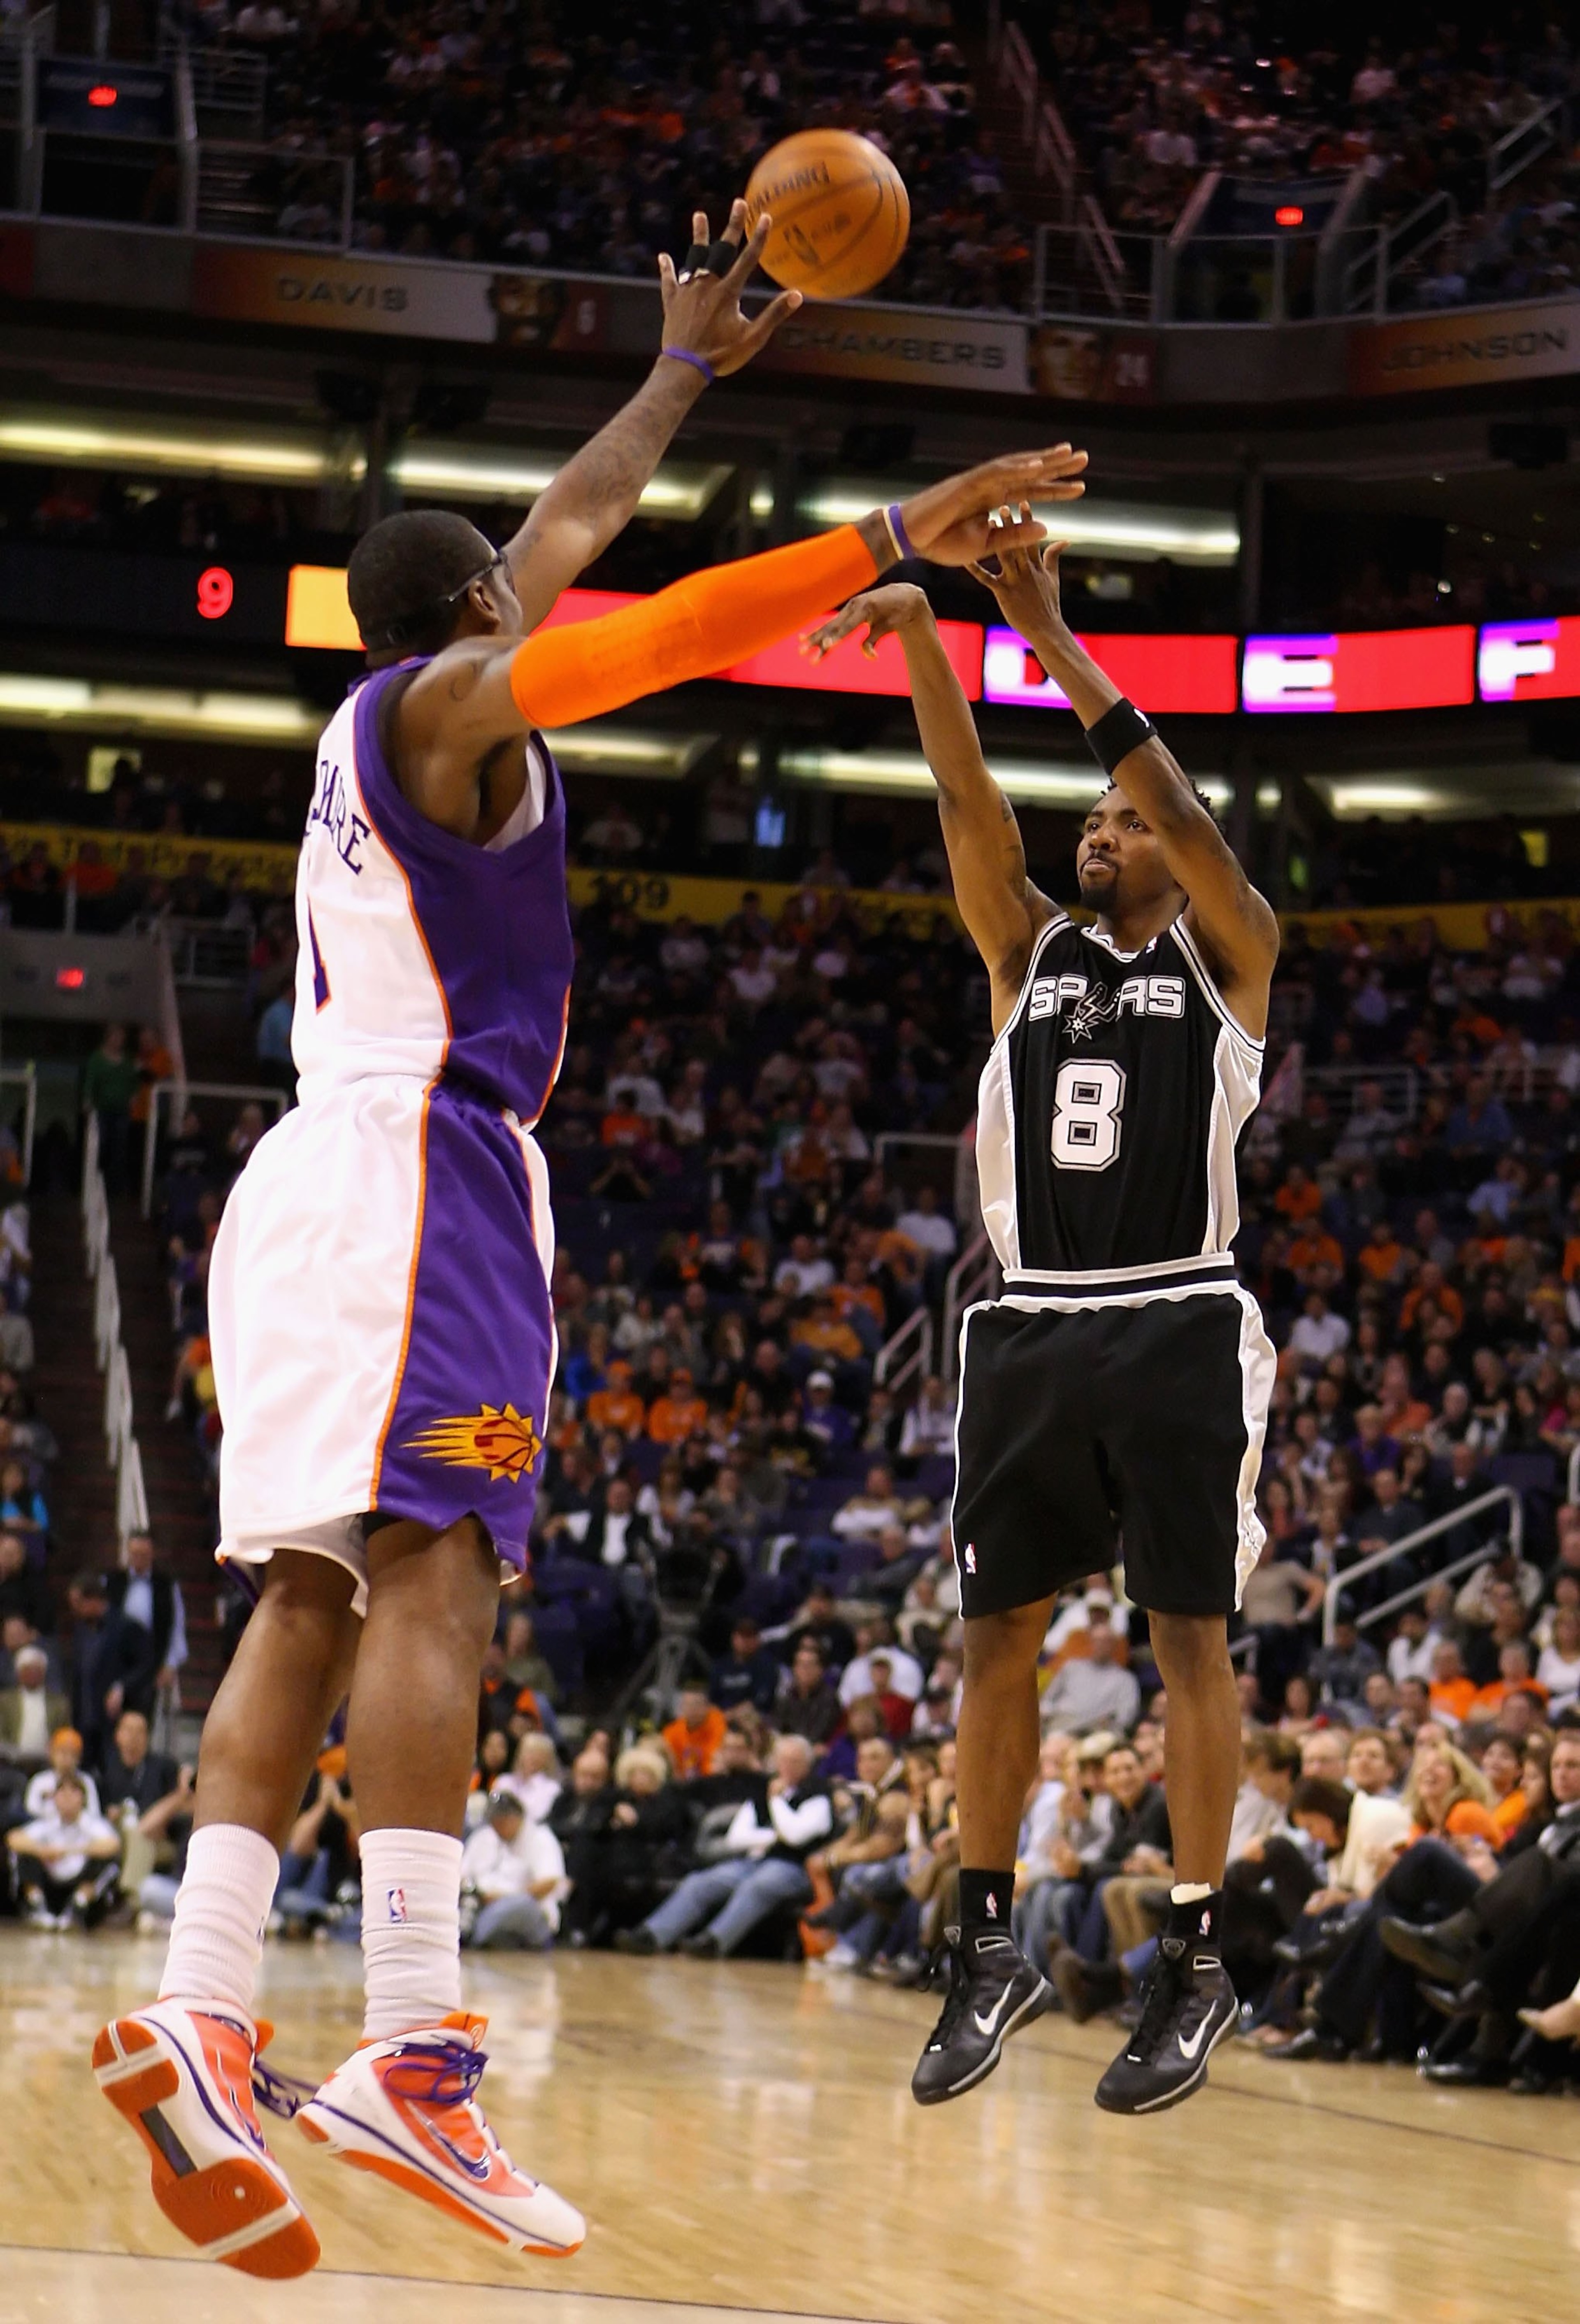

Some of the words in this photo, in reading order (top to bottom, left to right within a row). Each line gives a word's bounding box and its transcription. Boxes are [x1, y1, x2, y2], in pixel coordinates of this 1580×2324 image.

[277, 277, 407, 312] DAVIS
[781, 325, 1008, 369] CHAMBERS
[1382, 329, 1570, 370] JOHNSON
[196, 566, 233, 619] 9
[1243, 633, 1338, 713] E
[1480, 619, 1559, 702] F
[1028, 973, 1186, 1026] SPURS
[1050, 1057, 1127, 1172] 8
